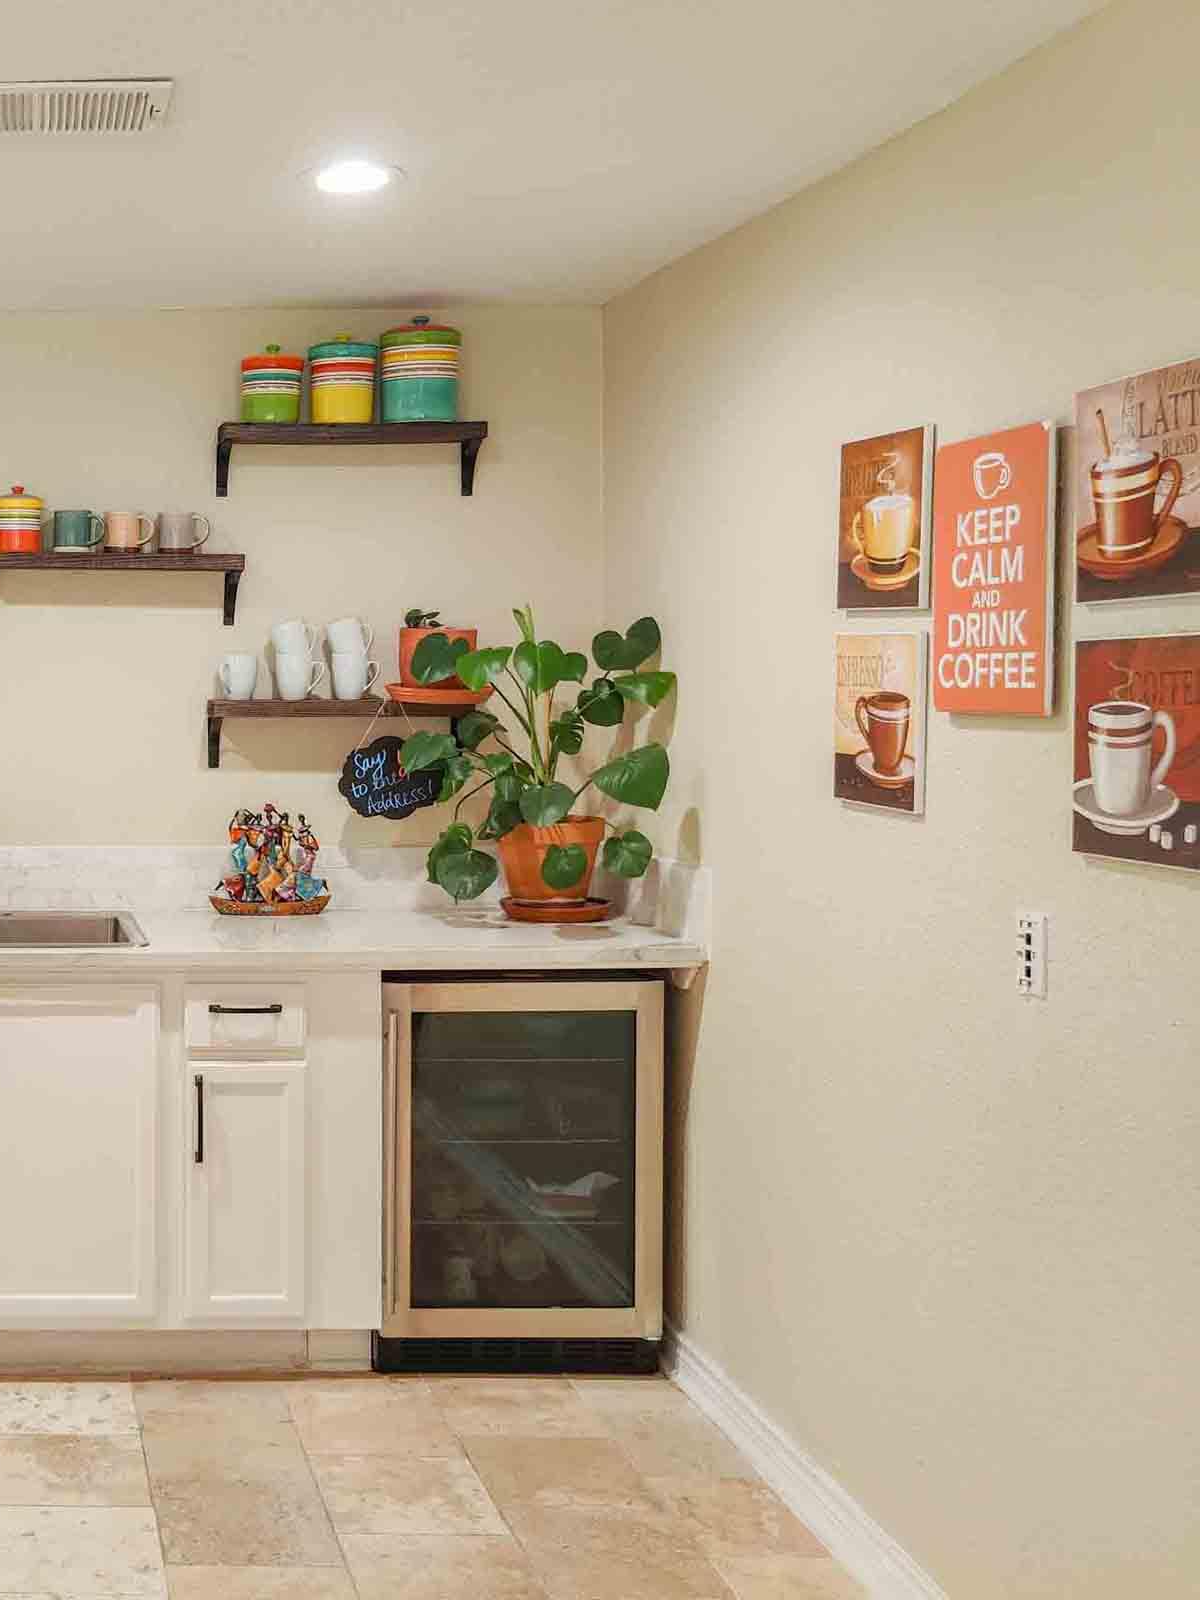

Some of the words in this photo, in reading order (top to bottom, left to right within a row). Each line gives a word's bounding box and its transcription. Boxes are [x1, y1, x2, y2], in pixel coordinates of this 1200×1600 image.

[956, 504, 1021, 547] KEEP
[952, 545, 1025, 588] CALM
[972, 589, 1001, 609] AND
[947, 609, 1028, 648] DRINK
[938, 652, 1037, 689] COFFEE
[354, 749, 386, 780] Say
[352, 783, 368, 798] to
[373, 771, 401, 792] the
